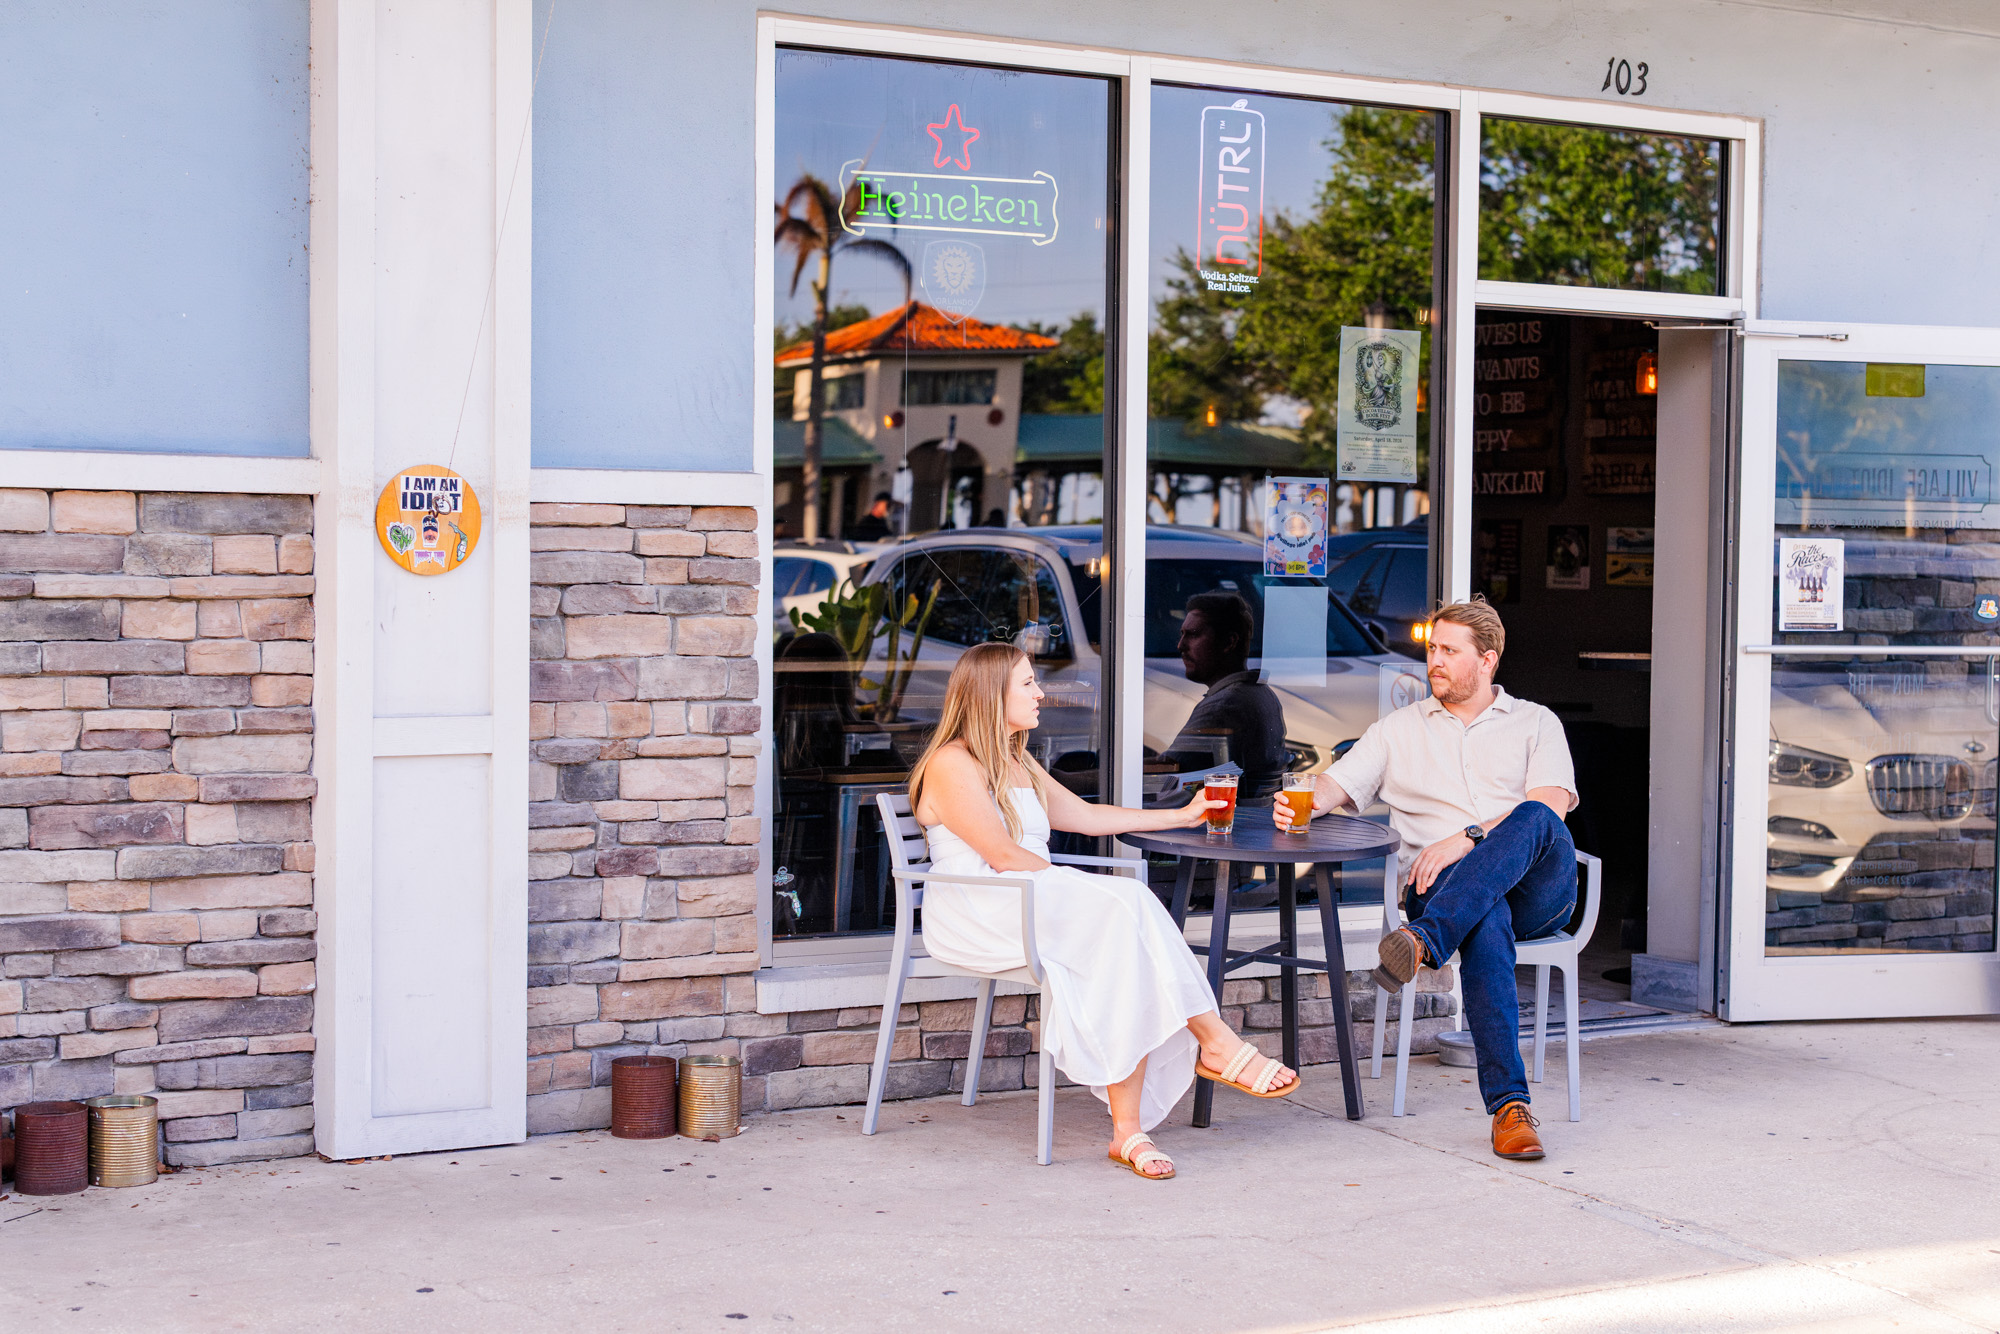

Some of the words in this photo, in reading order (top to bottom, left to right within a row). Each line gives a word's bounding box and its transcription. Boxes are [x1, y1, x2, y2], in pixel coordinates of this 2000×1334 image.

[1601, 56, 1649, 96] 103
[856, 176, 1042, 227] Heineken
[1207, 281, 1226, 292] Real
[1227, 282, 1252, 293] Juice.
[936, 297, 974, 306] ORLANDO
[947, 305, 963, 313] CITY
[1519, 320, 1543, 344] US
[1500, 391, 1526, 414] BE
[405, 477, 409, 490] I
[414, 478, 436, 491] AM
[440, 478, 458, 491] AN
[1807, 544, 1822, 556] the
[1787, 550, 1828, 568] Races
